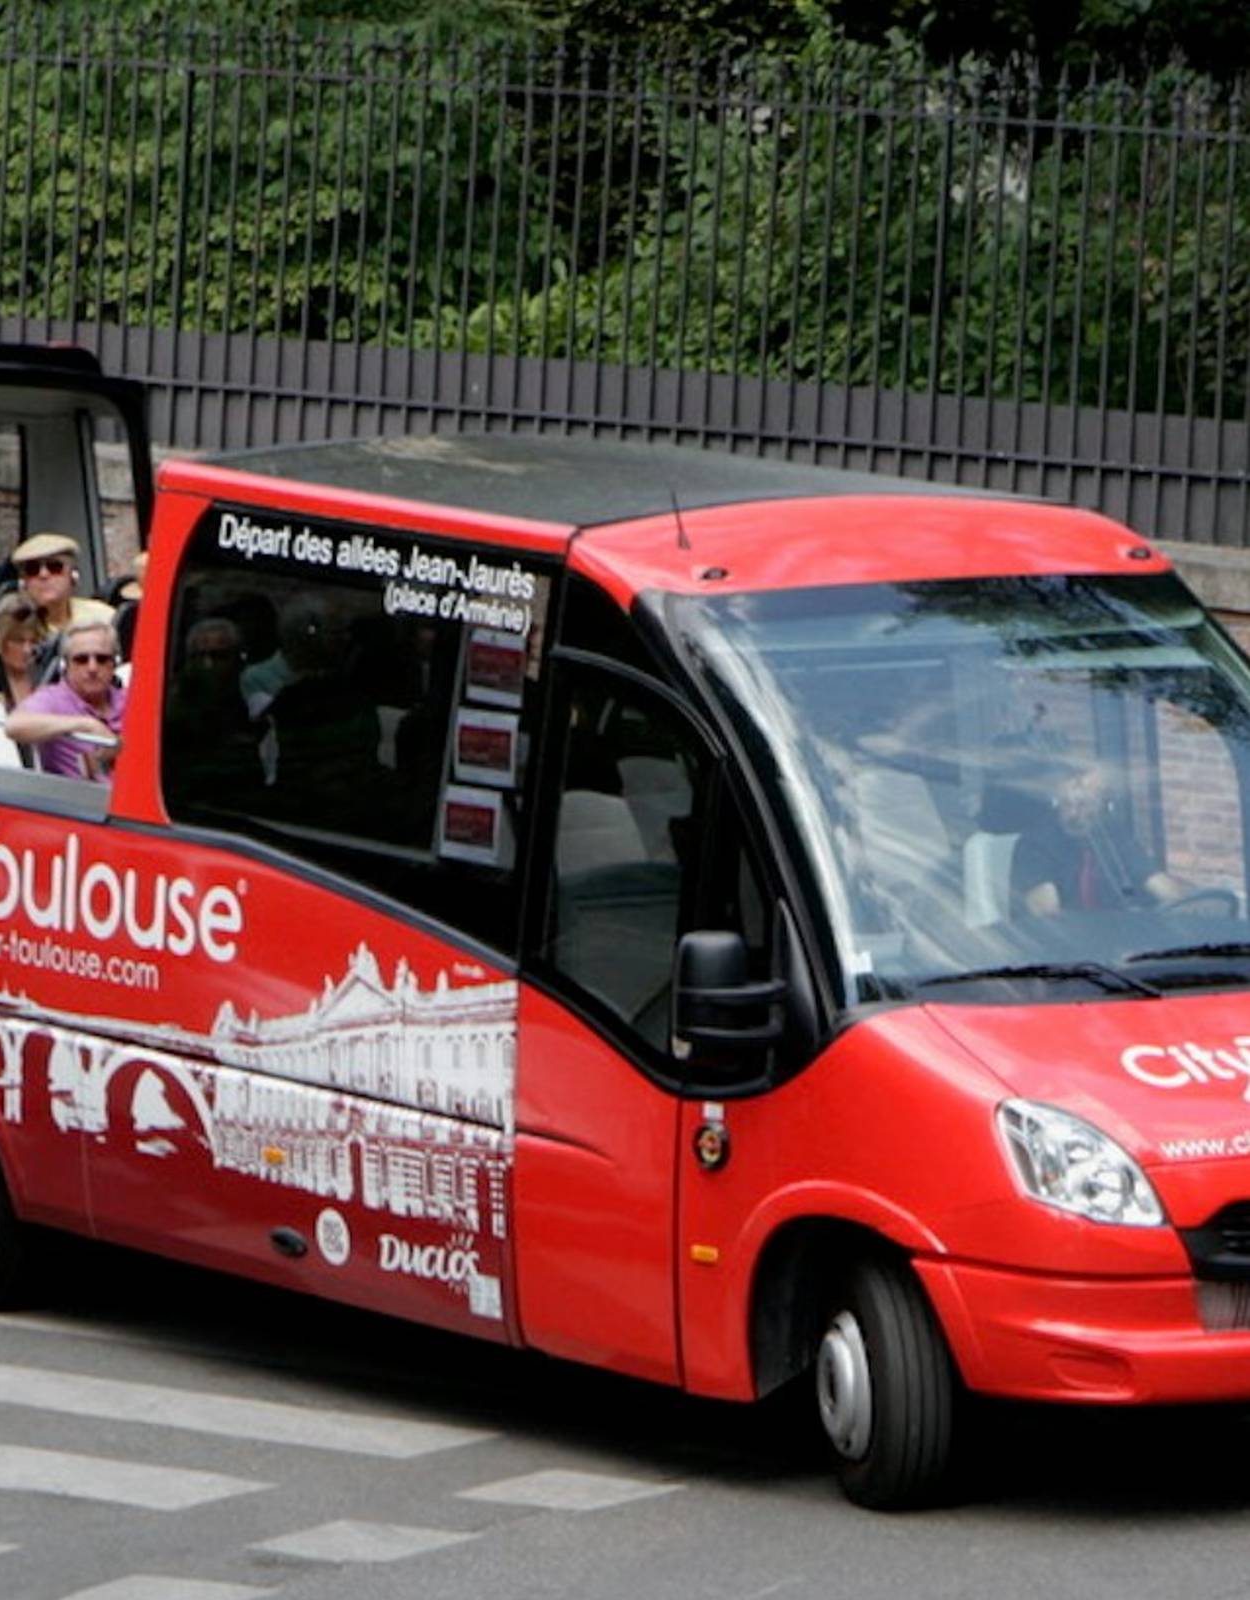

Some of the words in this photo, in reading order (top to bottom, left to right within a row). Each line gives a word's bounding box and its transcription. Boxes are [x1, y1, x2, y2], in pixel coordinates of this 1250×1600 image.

[218, 512, 292, 560] Départ
[292, 525, 334, 565] des
[336, 535, 401, 577] allées
[403, 544, 535, 600] Jean-Jaurès
